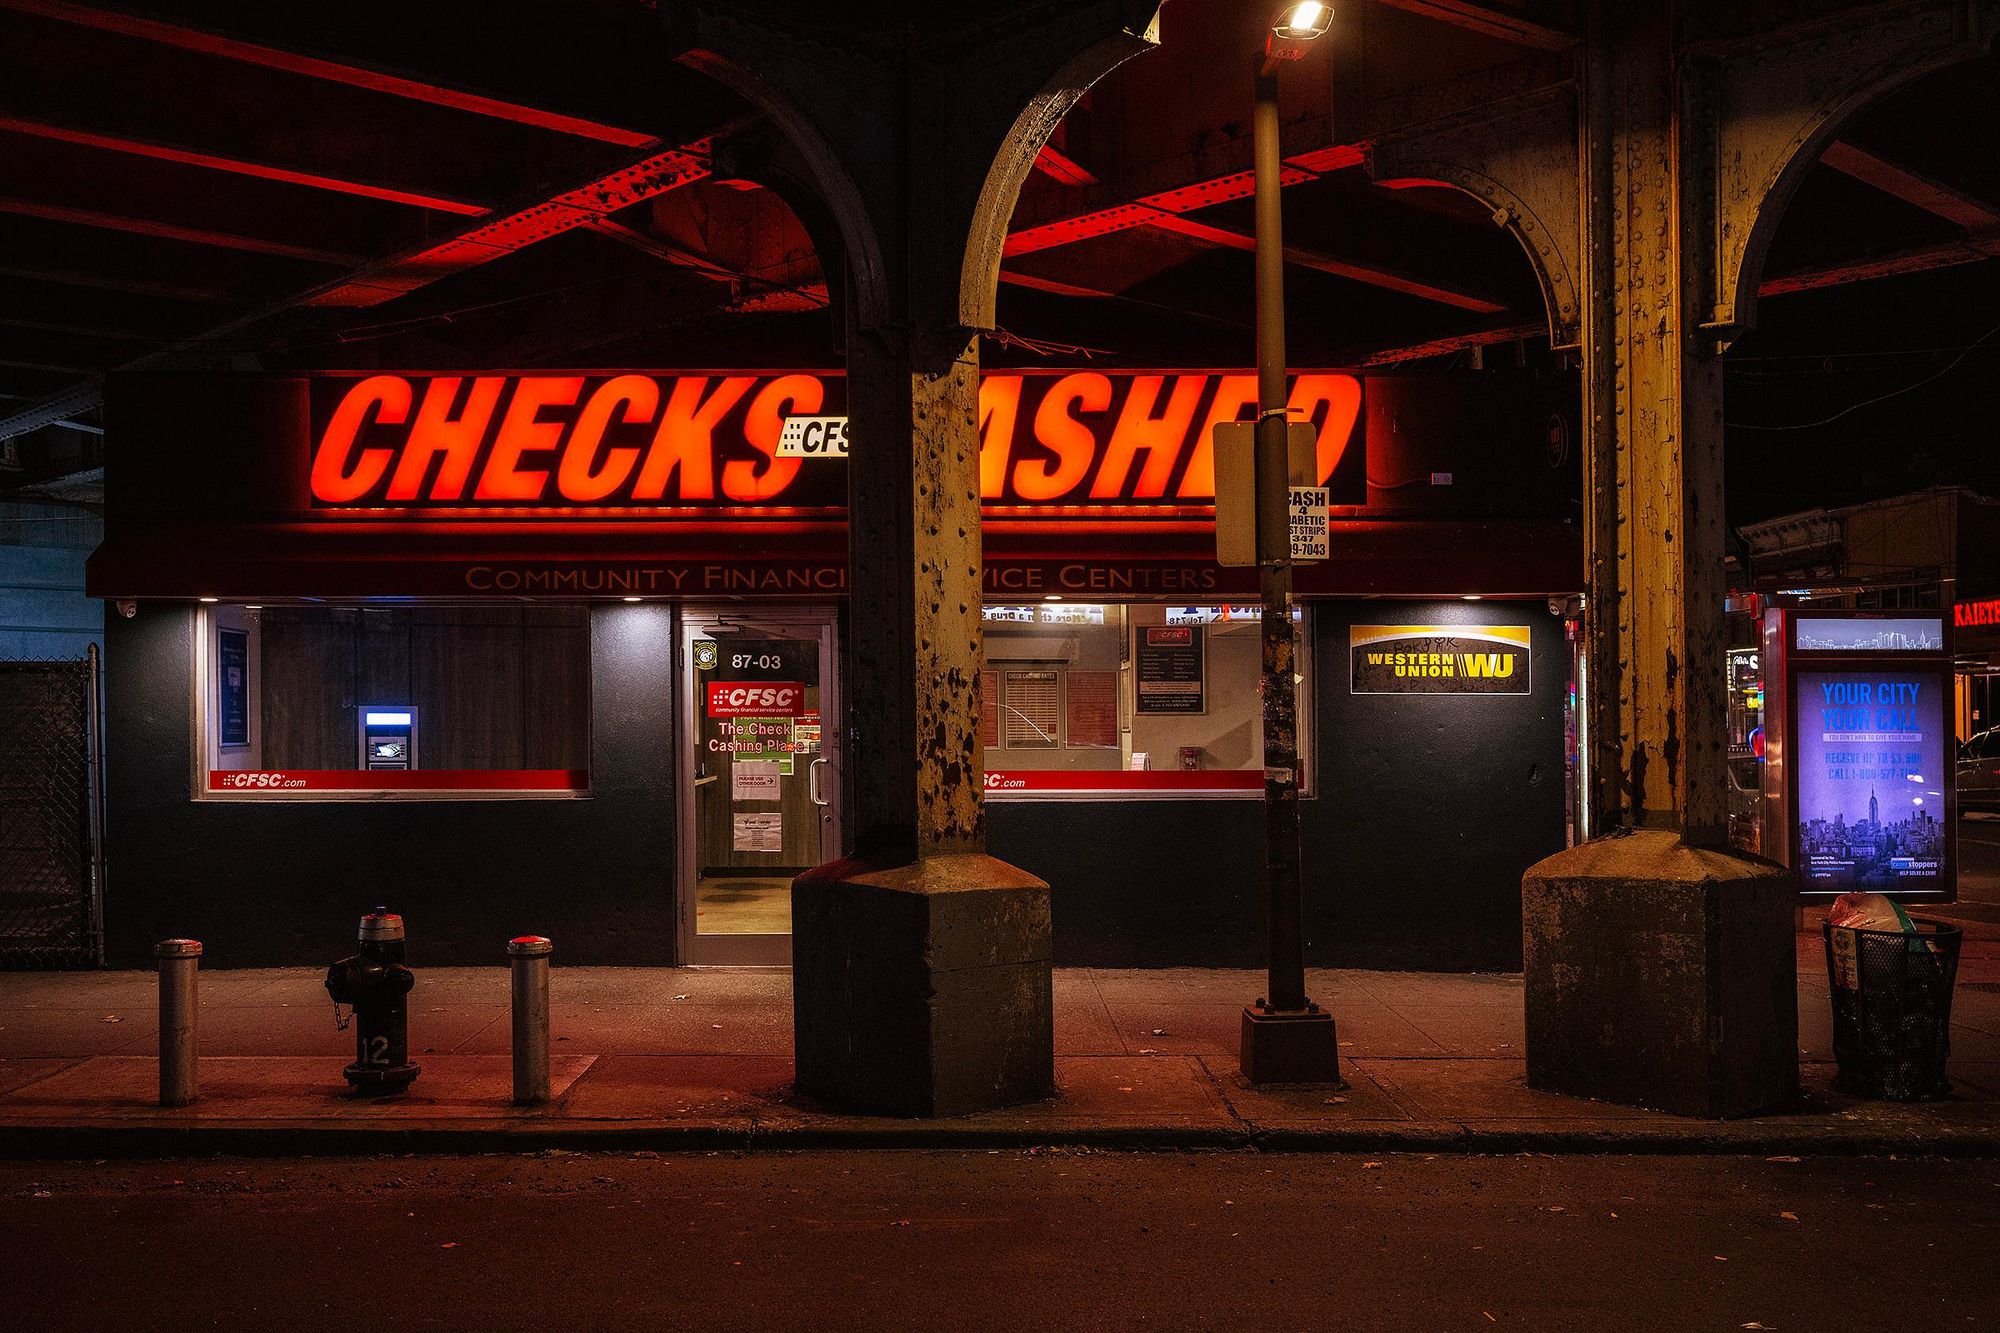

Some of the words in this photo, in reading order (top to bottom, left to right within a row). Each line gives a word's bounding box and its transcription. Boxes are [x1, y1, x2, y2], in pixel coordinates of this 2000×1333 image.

[310, 374, 825, 503] CHECKS
[979, 372, 1362, 501] ASHED
[802, 421, 849, 453] CFS
[1298, 506, 1308, 515] 4
[1289, 515, 1326, 526] ABETIC
[1299, 526, 1326, 535] STRIPS
[1291, 543, 1326, 555] 9-7043
[465, 566, 690, 591] COMMUNITY
[704, 565, 846, 590] FINANCI
[1059, 564, 1216, 588] CENTERS
[731, 654, 782, 669] 87-03
[1367, 653, 1454, 665] WESTERN
[1463, 653, 1515, 678] WU
[1394, 665, 1454, 677] UNION
[729, 688, 794, 706] CFSC
[1822, 682, 1873, 705] YOUR
[1878, 682, 1921, 705] CITY
[1822, 708, 1871, 731] YOUR
[1876, 708, 1921, 731] CALL
[718, 722, 744, 735] The
[748, 722, 792, 735] Check
[708, 738, 763, 753] Cashing
[234, 773, 307, 787] CFSC.com
[1828, 768, 1849, 780] CALL
[1908, 861, 1938, 869] stoppers
[361, 1035, 391, 1064] 12
